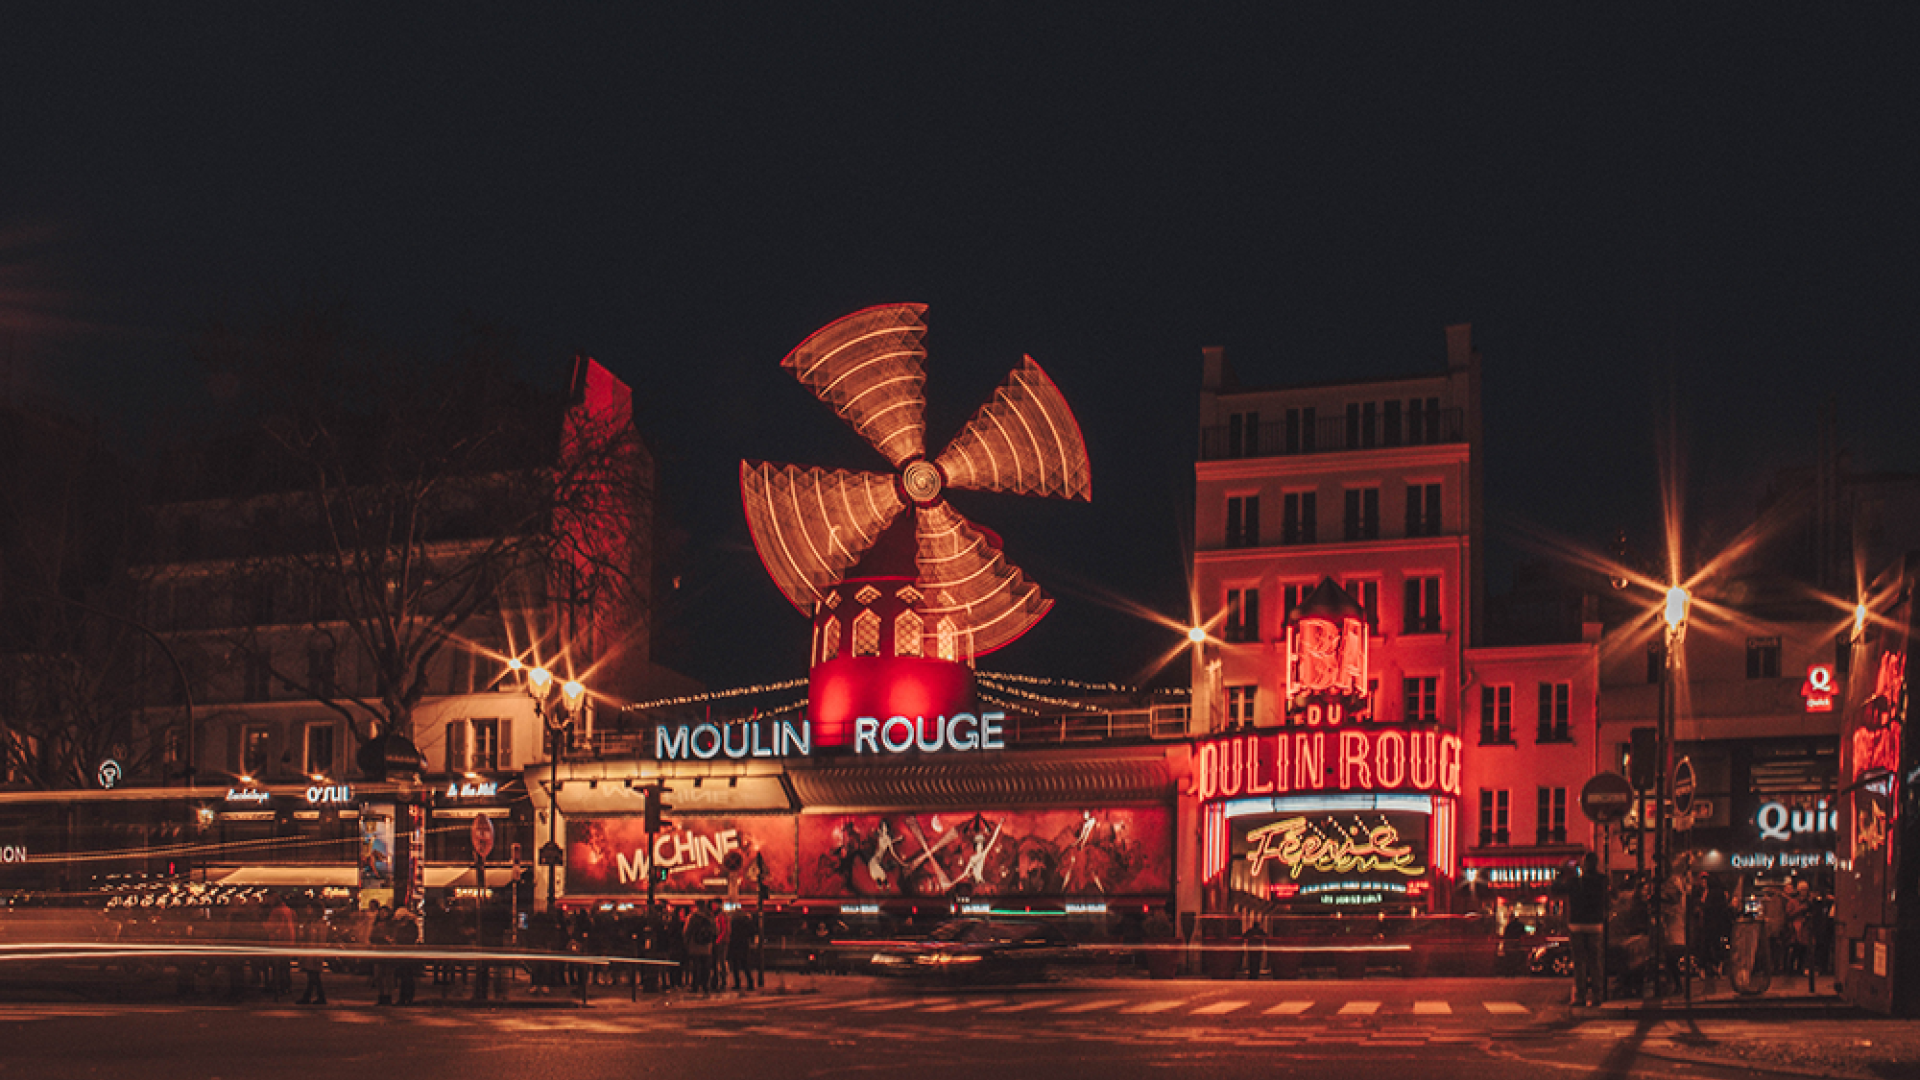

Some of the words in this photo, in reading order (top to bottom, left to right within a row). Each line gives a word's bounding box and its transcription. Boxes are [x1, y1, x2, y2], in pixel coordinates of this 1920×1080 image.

[1810, 667, 1831, 691] Q
[1307, 703, 1342, 726] DU
[655, 720, 811, 760] MOULIN
[855, 711, 1005, 755] ROUGE
[1199, 731, 1324, 802] OULIN
[1339, 731, 1462, 796] ROUG
[616, 829, 739, 885] MCHINE
[1731, 852, 1775, 870] Quality
[1780, 852, 1819, 869] Burger
